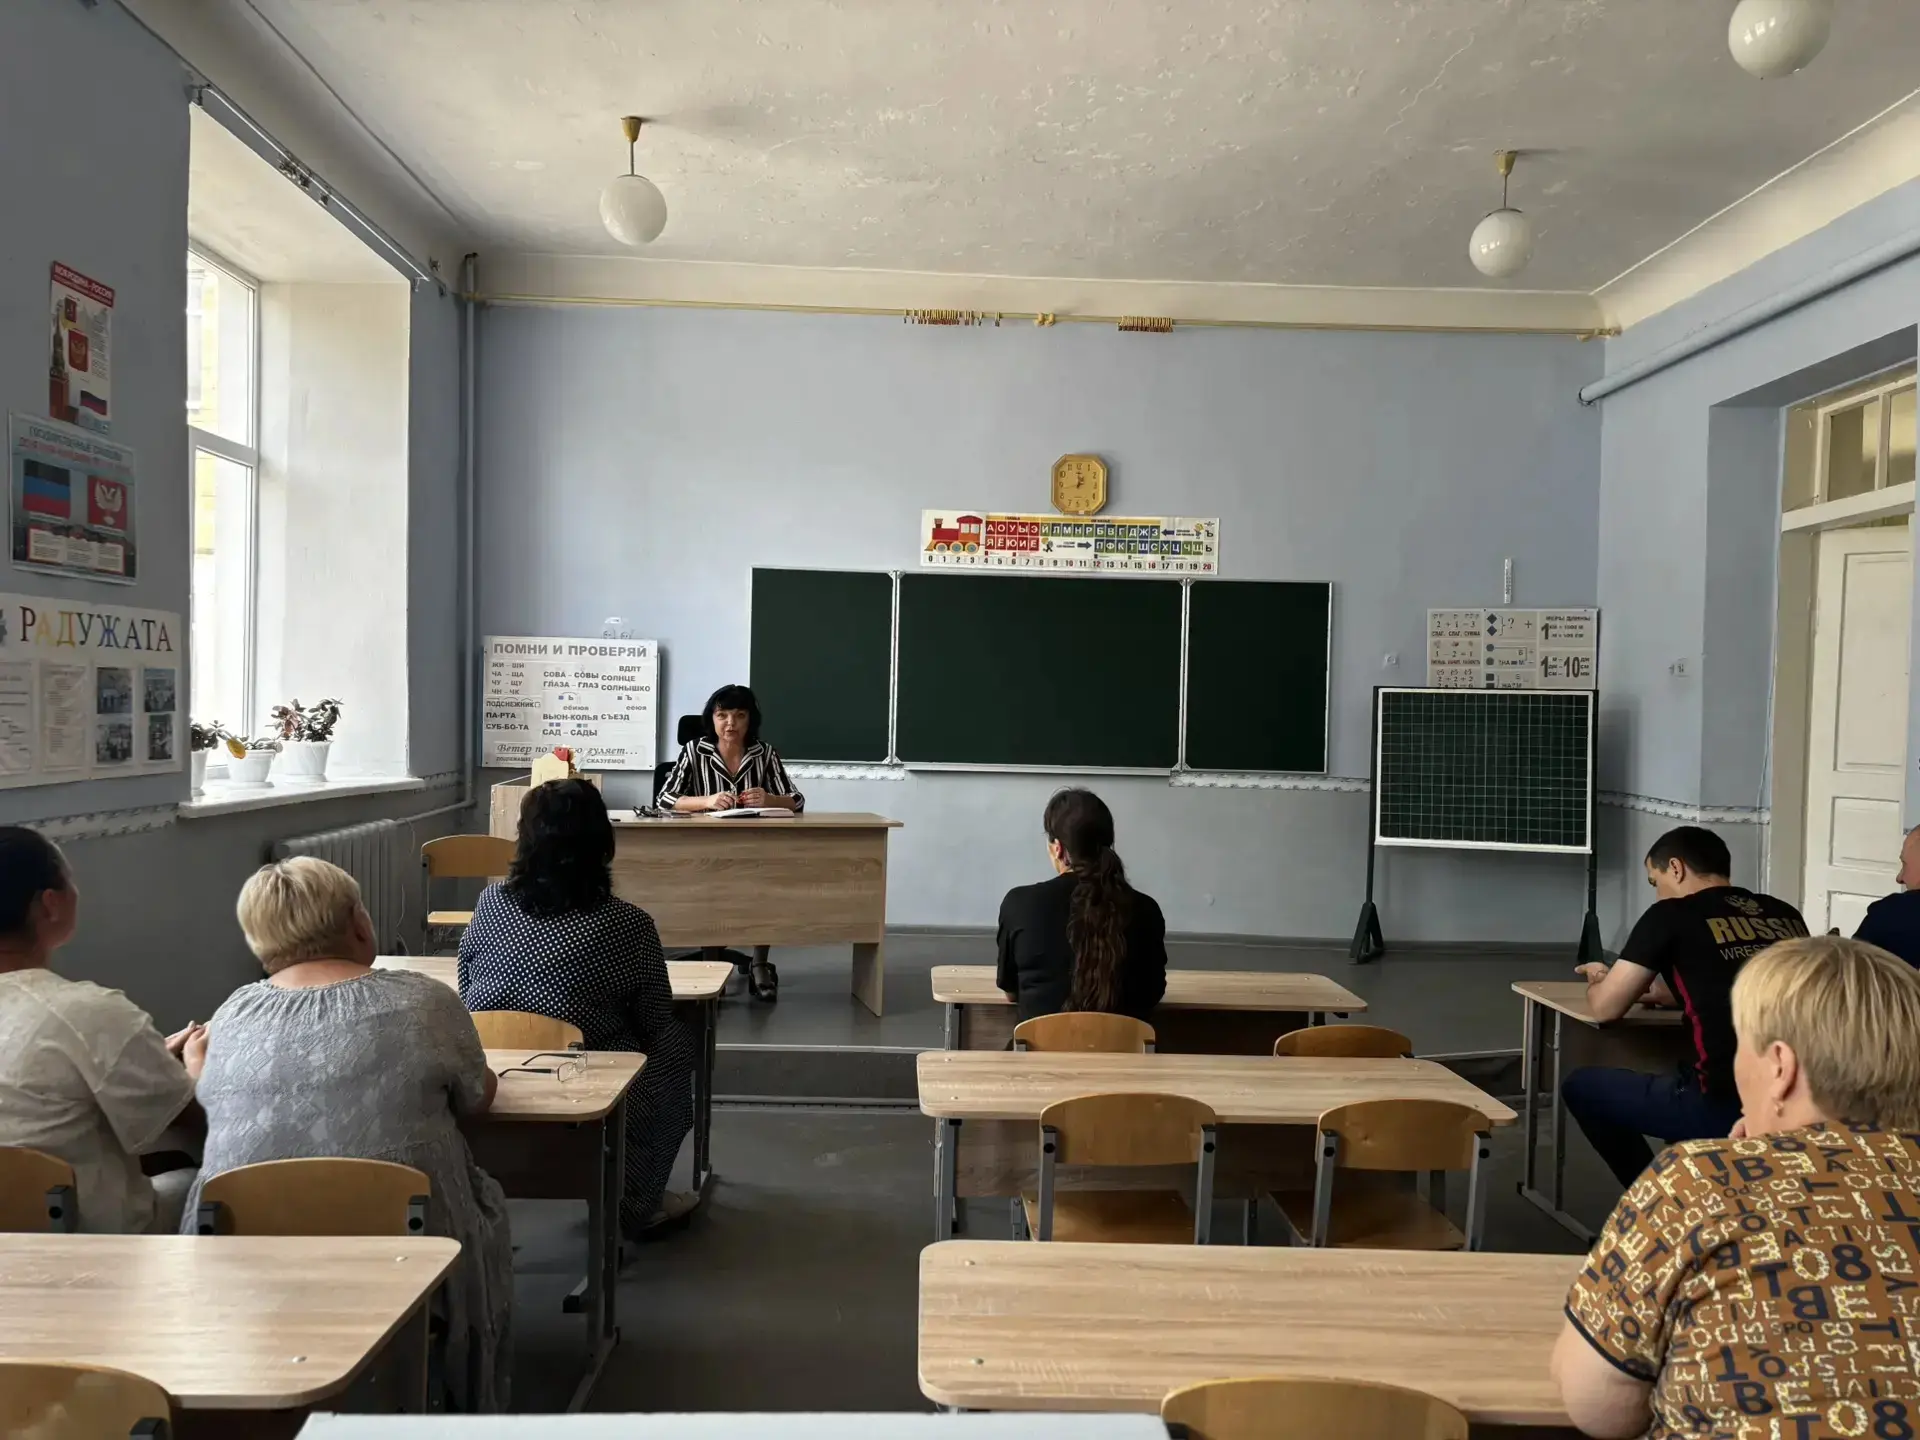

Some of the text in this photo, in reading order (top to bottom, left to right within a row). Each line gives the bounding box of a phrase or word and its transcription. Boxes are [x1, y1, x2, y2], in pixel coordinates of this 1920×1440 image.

[1172, 544, 1179, 552] Ц
[19, 605, 174, 652] РАДУЖАТА
[1541, 623, 1549, 640] 1
[494, 643, 647, 657] ПОМНИ И ПРОВЕРЯЙ
[1541, 656, 1548, 677] 1
[1564, 656, 1580, 678] 10
[497, 744, 532, 755] Ветер
[1719, 944, 1769, 961] WRES
